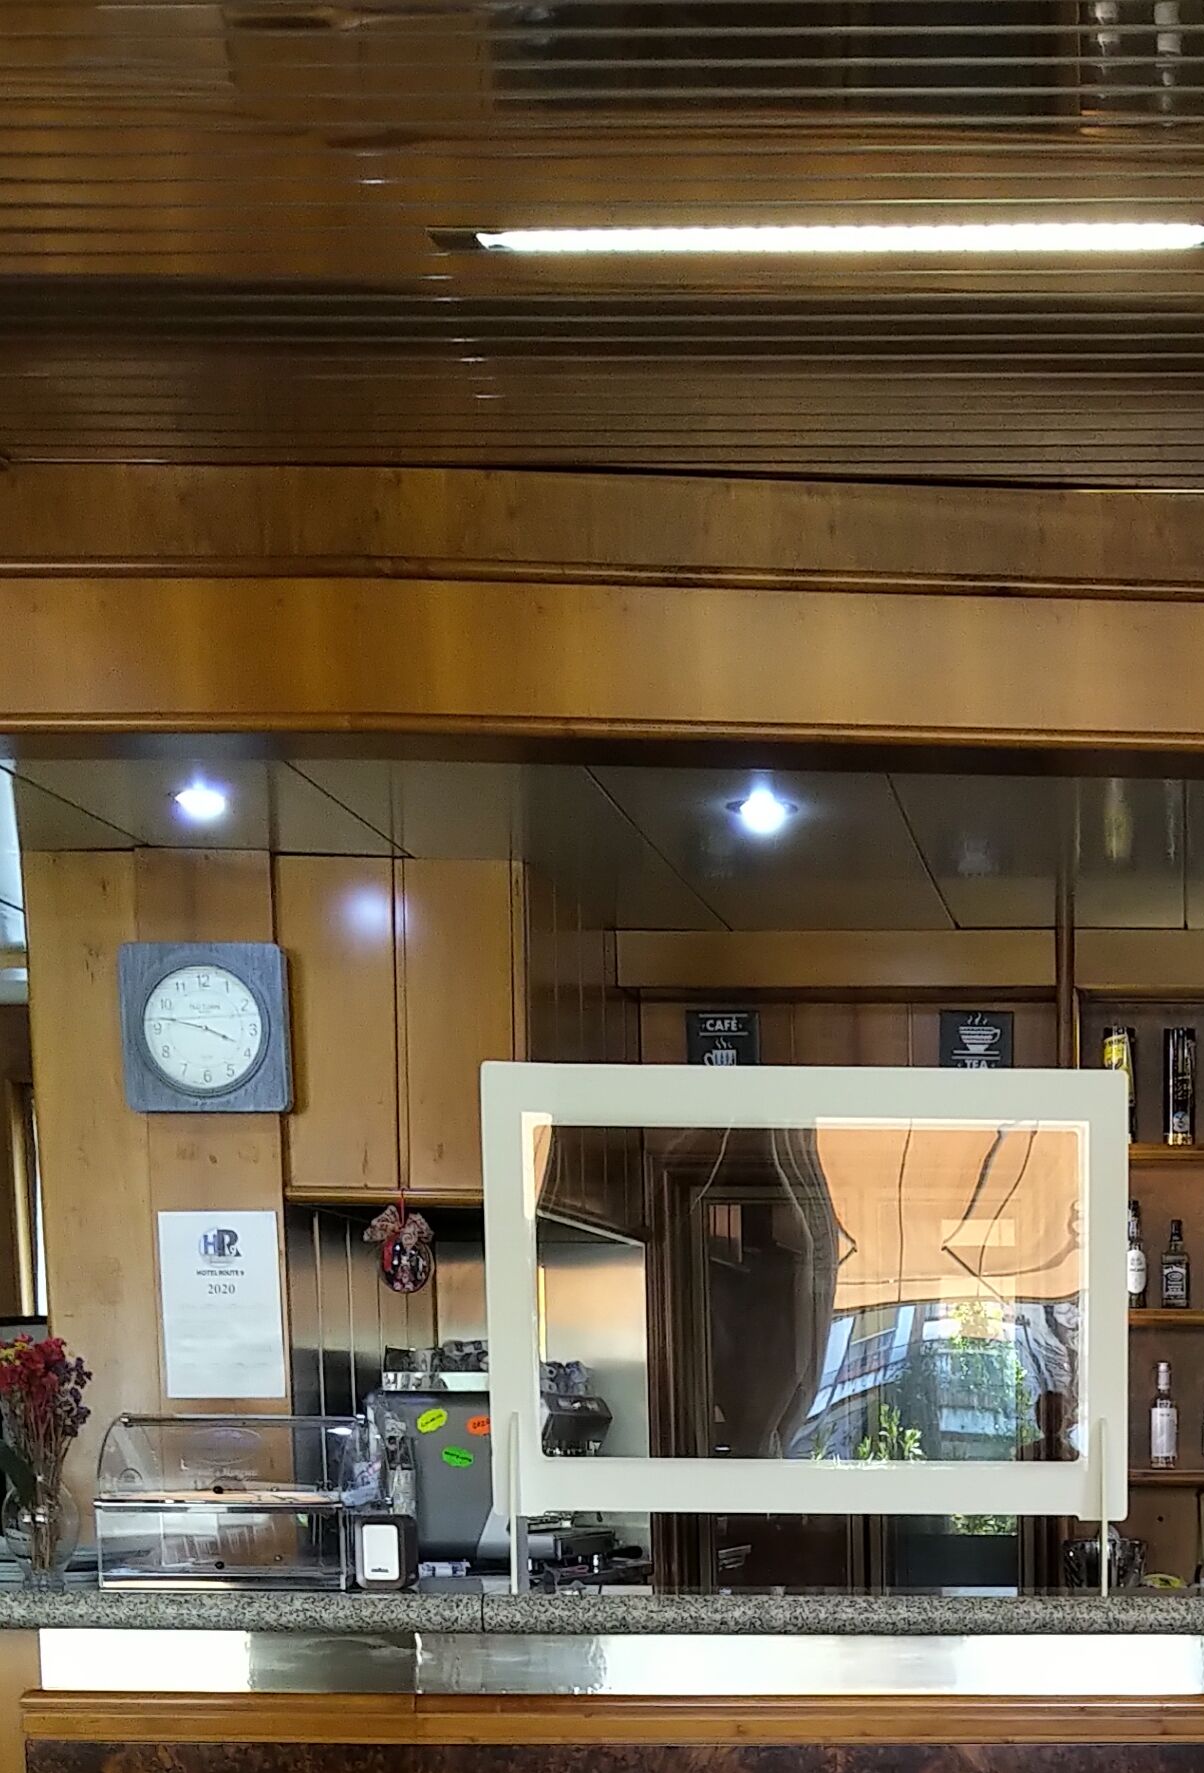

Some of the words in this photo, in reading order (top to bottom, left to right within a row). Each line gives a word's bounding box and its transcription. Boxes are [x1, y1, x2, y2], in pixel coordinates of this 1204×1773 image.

[175, 981, 186, 992] 11
[197, 975, 211, 988] 12
[160, 998, 173, 1011] 10
[240, 998, 249, 1012] 2
[153, 1022, 162, 1035] 9
[249, 1023, 258, 1037] 3
[706, 1016, 738, 1031] CAFÉ
[161, 1045, 170, 1059] 8
[243, 1047, 251, 1058] 4
[180, 1063, 188, 1077] 7
[203, 1070, 212, 1083] 6
[226, 1063, 235, 1078] 5
[208, 1283, 236, 1295] 2020
